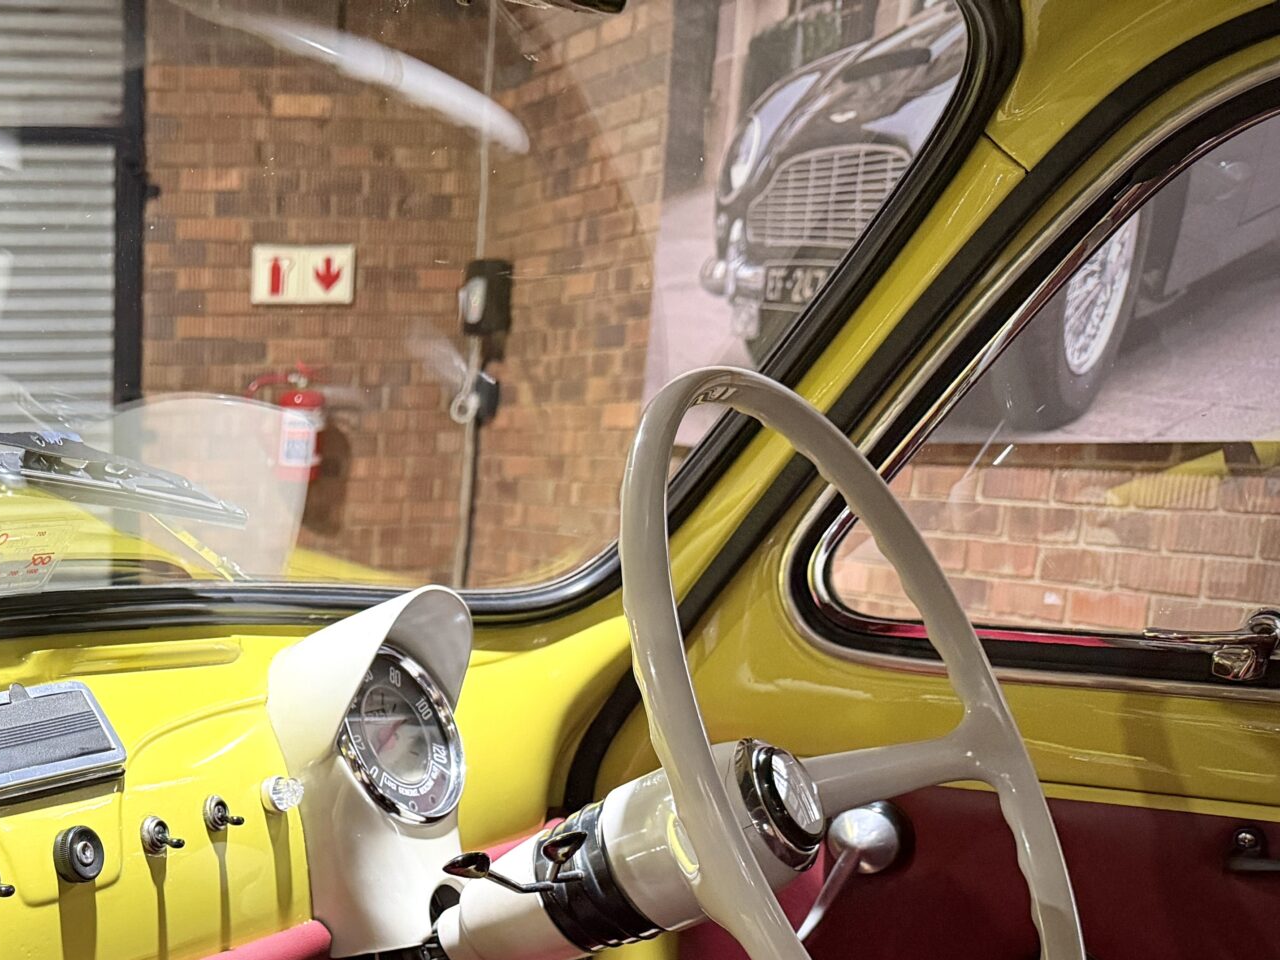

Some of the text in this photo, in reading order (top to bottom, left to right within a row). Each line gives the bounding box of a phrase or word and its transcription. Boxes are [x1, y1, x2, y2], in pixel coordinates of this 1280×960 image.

[389, 666, 402, 688] 80
[415, 696, 433, 721] 100
[431, 742, 448, 764] 120
